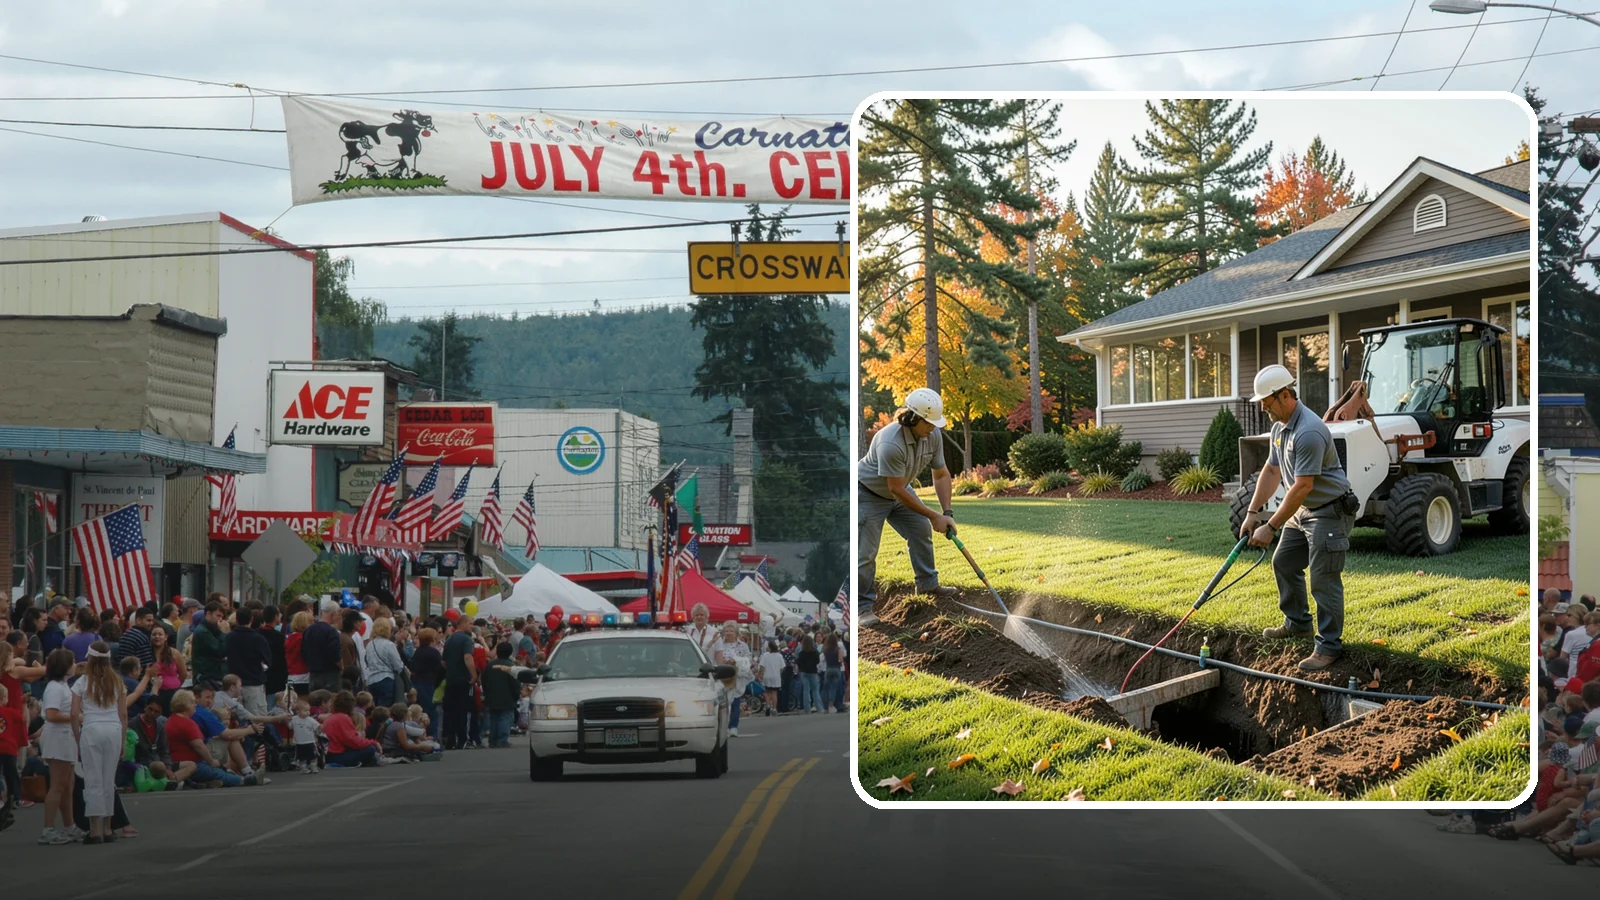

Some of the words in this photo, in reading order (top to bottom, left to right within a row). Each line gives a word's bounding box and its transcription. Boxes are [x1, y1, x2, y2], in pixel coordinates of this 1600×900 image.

[481, 141, 604, 192] JULY
[632, 150, 746, 197] 4th.
[697, 254, 850, 279] CROSSWA
[283, 380, 373, 419] ACE
[405, 409, 453, 422] CEDAR
[283, 421, 370, 436] Hardware
[353, 467, 386, 480] Simpl
[95, 485, 124, 495] Vincent
[126, 486, 136, 495] de
[137, 486, 155, 495] Paul
[688, 526, 741, 535] CRNATION
[699, 535, 730, 543] GLASS
